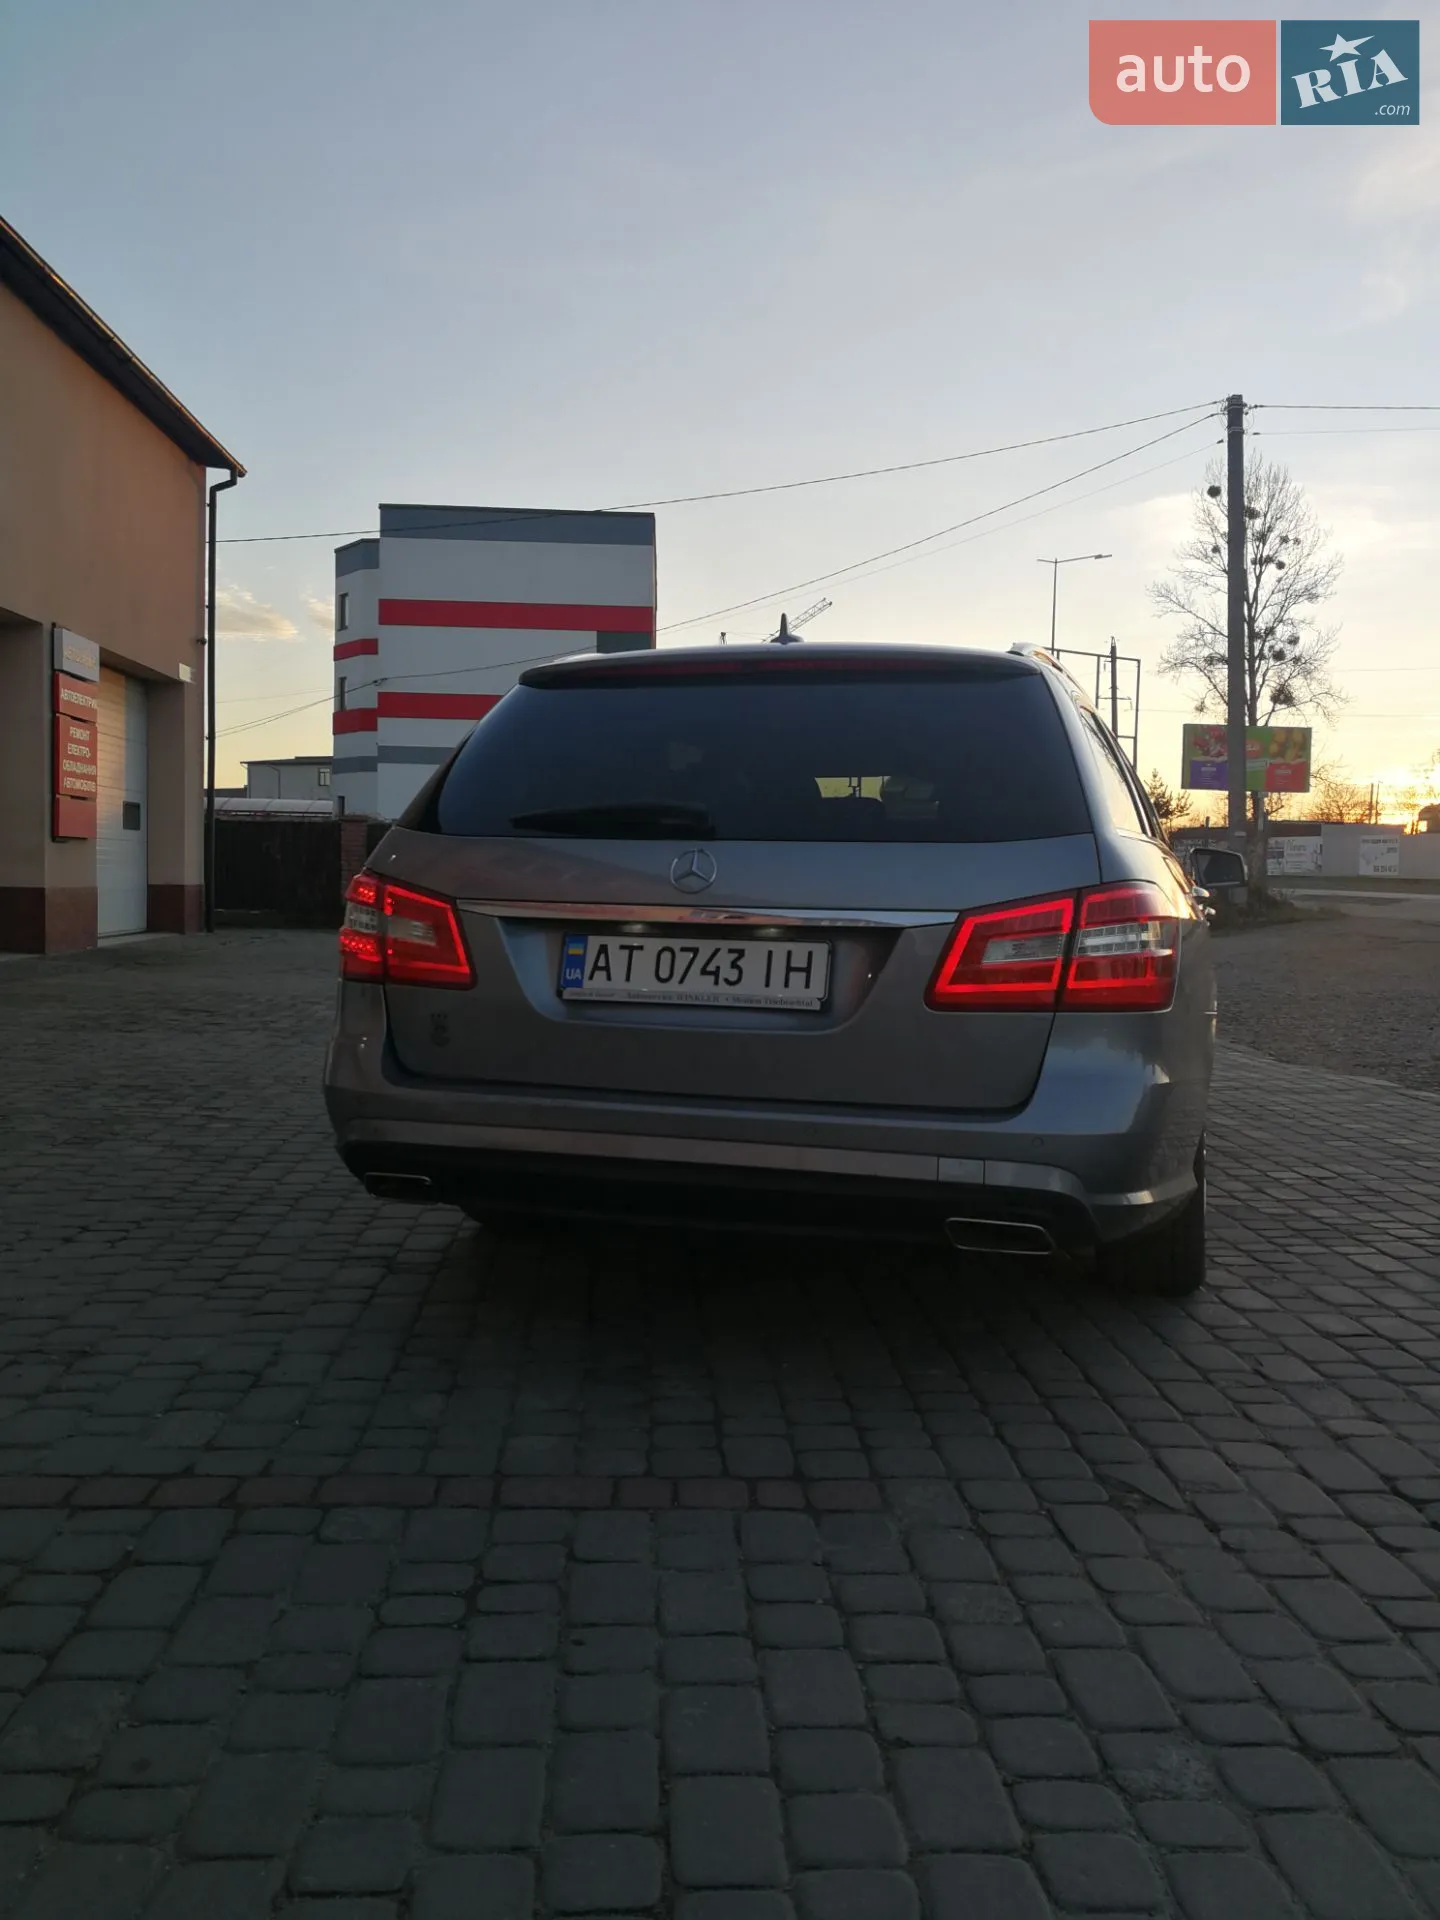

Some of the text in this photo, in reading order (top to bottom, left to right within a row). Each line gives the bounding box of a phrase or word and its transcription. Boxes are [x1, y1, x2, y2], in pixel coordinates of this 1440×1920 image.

[565, 968, 582, 981] UA
[588, 943, 813, 989] AT 0743 IH
